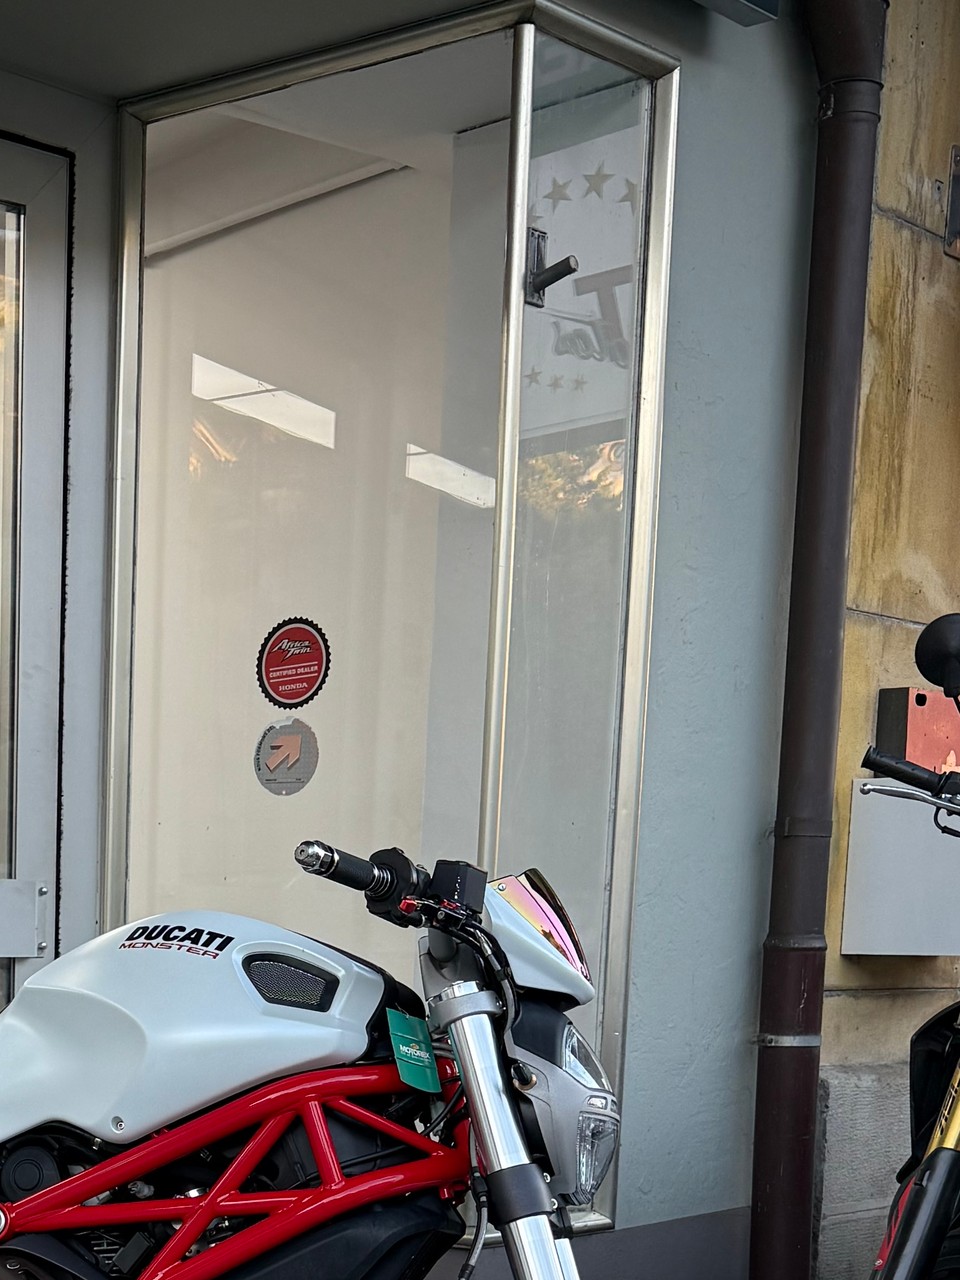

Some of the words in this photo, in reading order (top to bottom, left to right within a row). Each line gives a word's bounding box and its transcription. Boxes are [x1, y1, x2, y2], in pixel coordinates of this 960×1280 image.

[271, 639, 310, 652] Africa
[283, 647, 313, 659] Twin
[269, 668, 296, 678] CERTIFIED
[297, 665, 318, 674] DEALER
[279, 683, 308, 692] HONDA
[125, 925, 235, 952] DUCATI
[119, 942, 219, 960] MONSTER
[399, 1044, 431, 1059] MOTOREX
